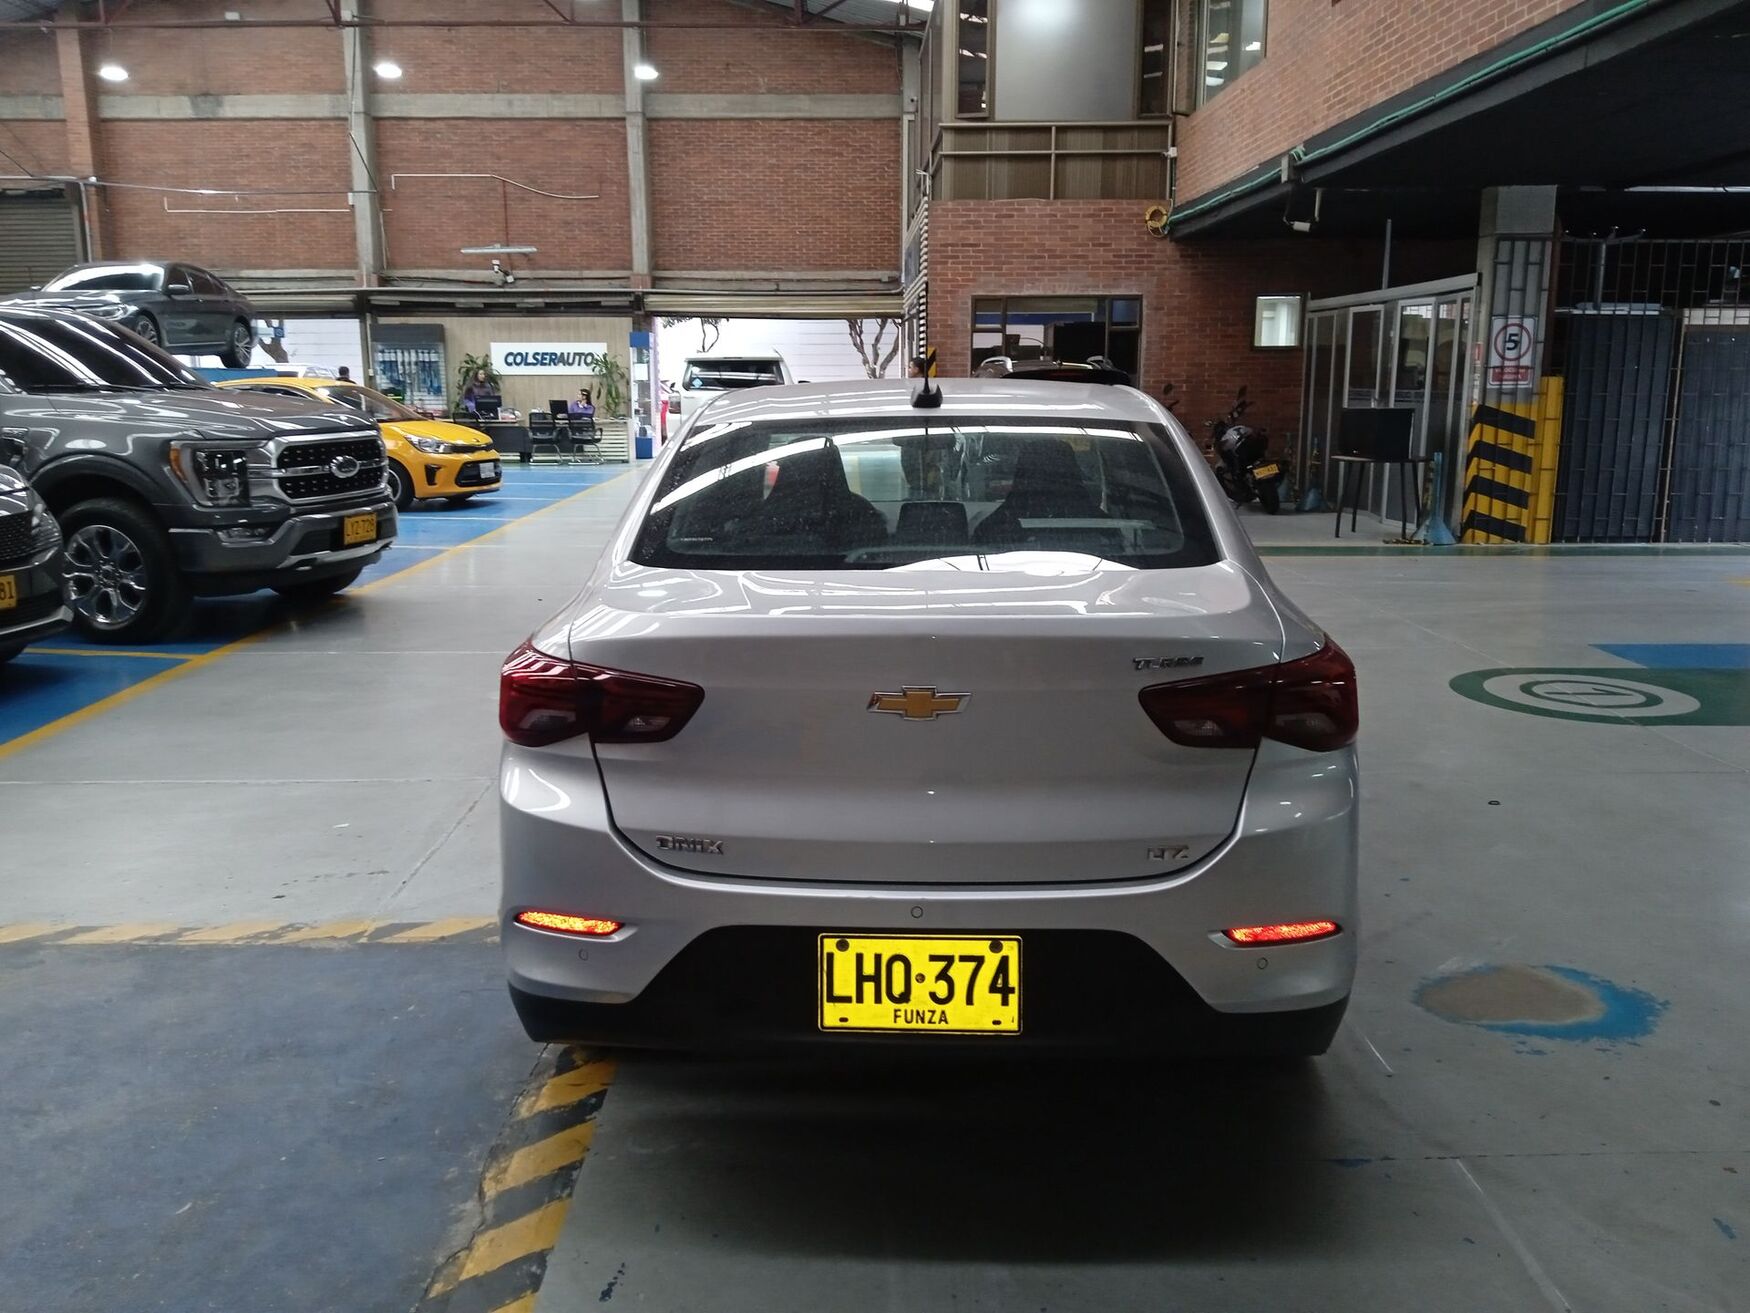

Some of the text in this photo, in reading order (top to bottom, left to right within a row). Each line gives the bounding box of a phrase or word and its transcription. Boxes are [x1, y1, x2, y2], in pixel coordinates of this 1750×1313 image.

[1506, 333, 1519, 351] 5
[504, 351, 595, 366] COLSERAUTO
[893, 1008, 949, 1024] FUNZA
